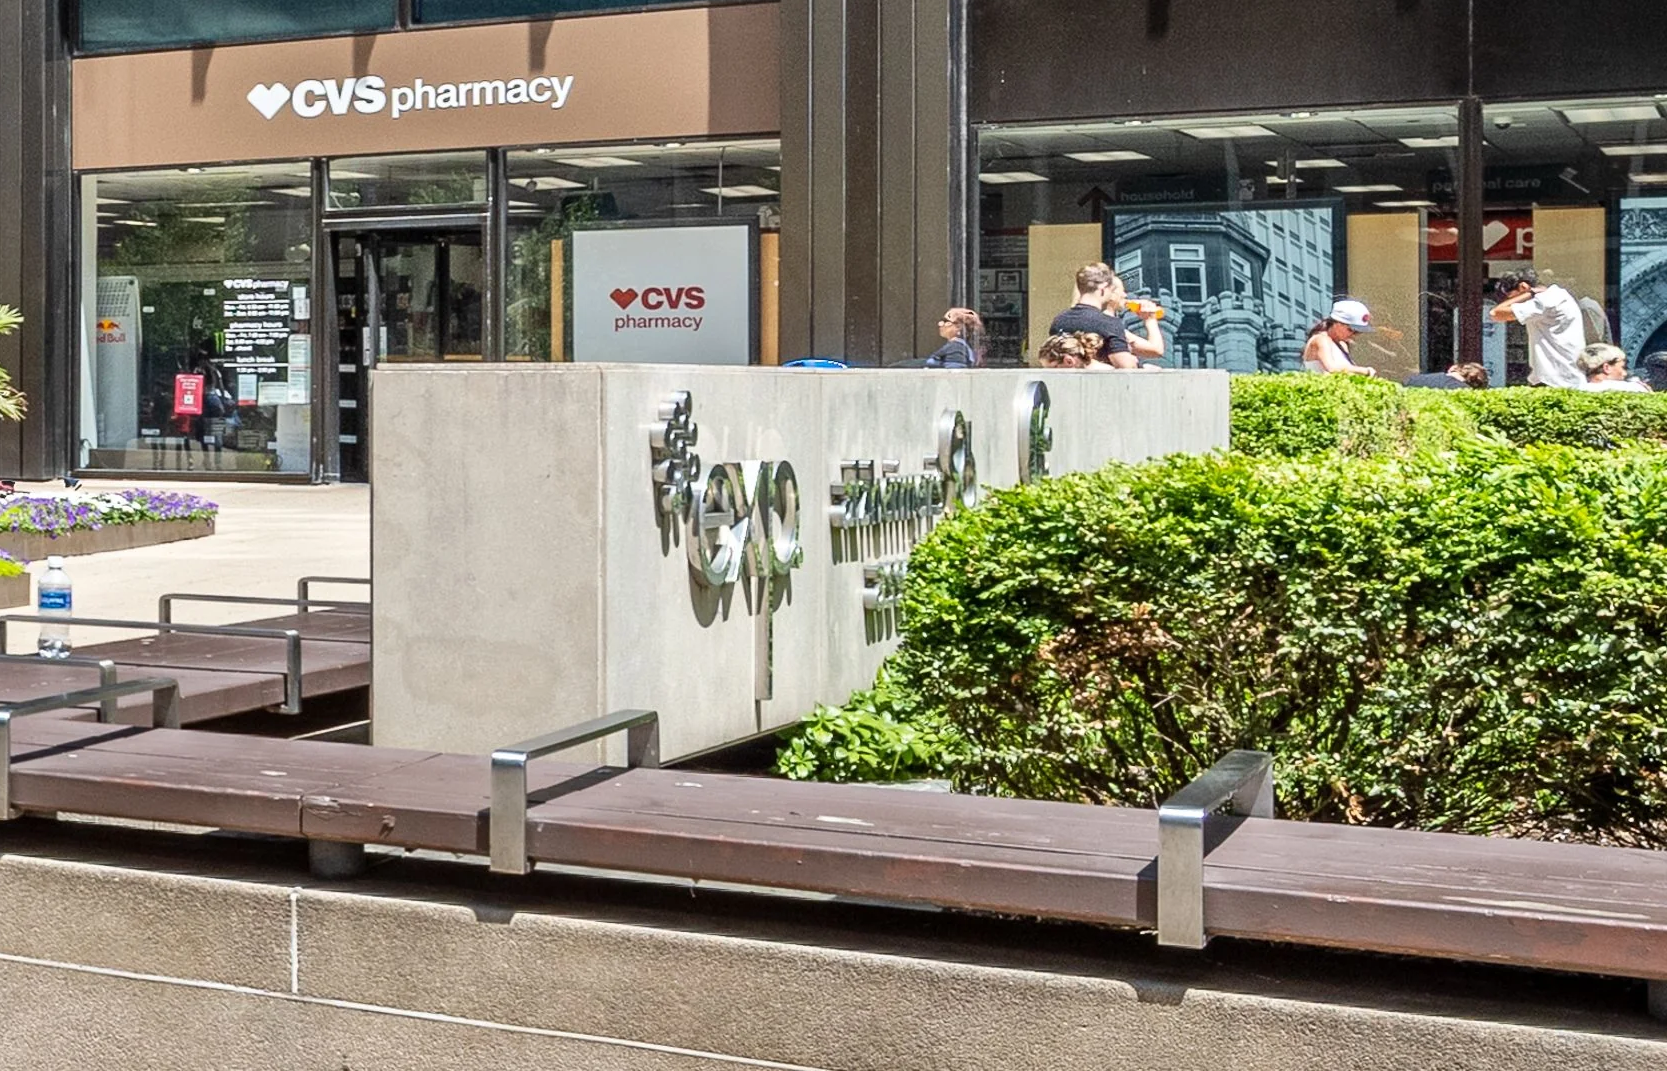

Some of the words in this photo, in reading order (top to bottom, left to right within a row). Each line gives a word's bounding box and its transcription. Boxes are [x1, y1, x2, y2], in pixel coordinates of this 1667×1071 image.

[291, 75, 387, 118] CVS
[391, 75, 574, 119] pharmacy
[1120, 188, 1195, 202] household
[641, 286, 705, 310] CVS
[614, 314, 704, 332] pharmacy
